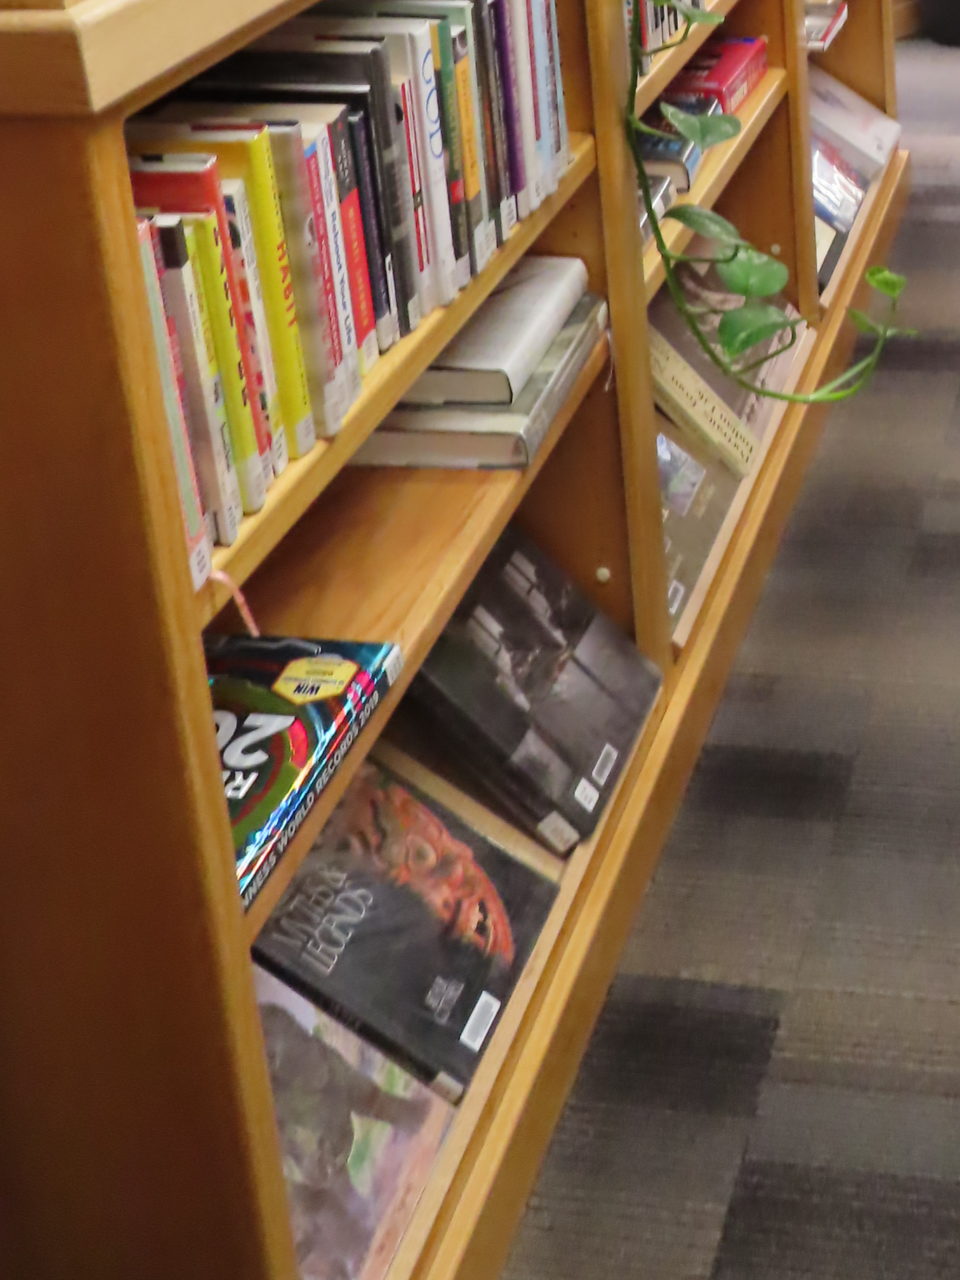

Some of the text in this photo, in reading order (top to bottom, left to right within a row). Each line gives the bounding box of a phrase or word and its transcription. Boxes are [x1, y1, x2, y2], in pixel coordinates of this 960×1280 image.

[277, 241, 298, 329] HABIT
[330, 210, 352, 346] Reboot Your Life
[293, 681, 321, 697] WIN
[277, 792, 315, 855] WORLD
[315, 725, 361, 794] RECORDS
[358, 691, 380, 727] 2019
